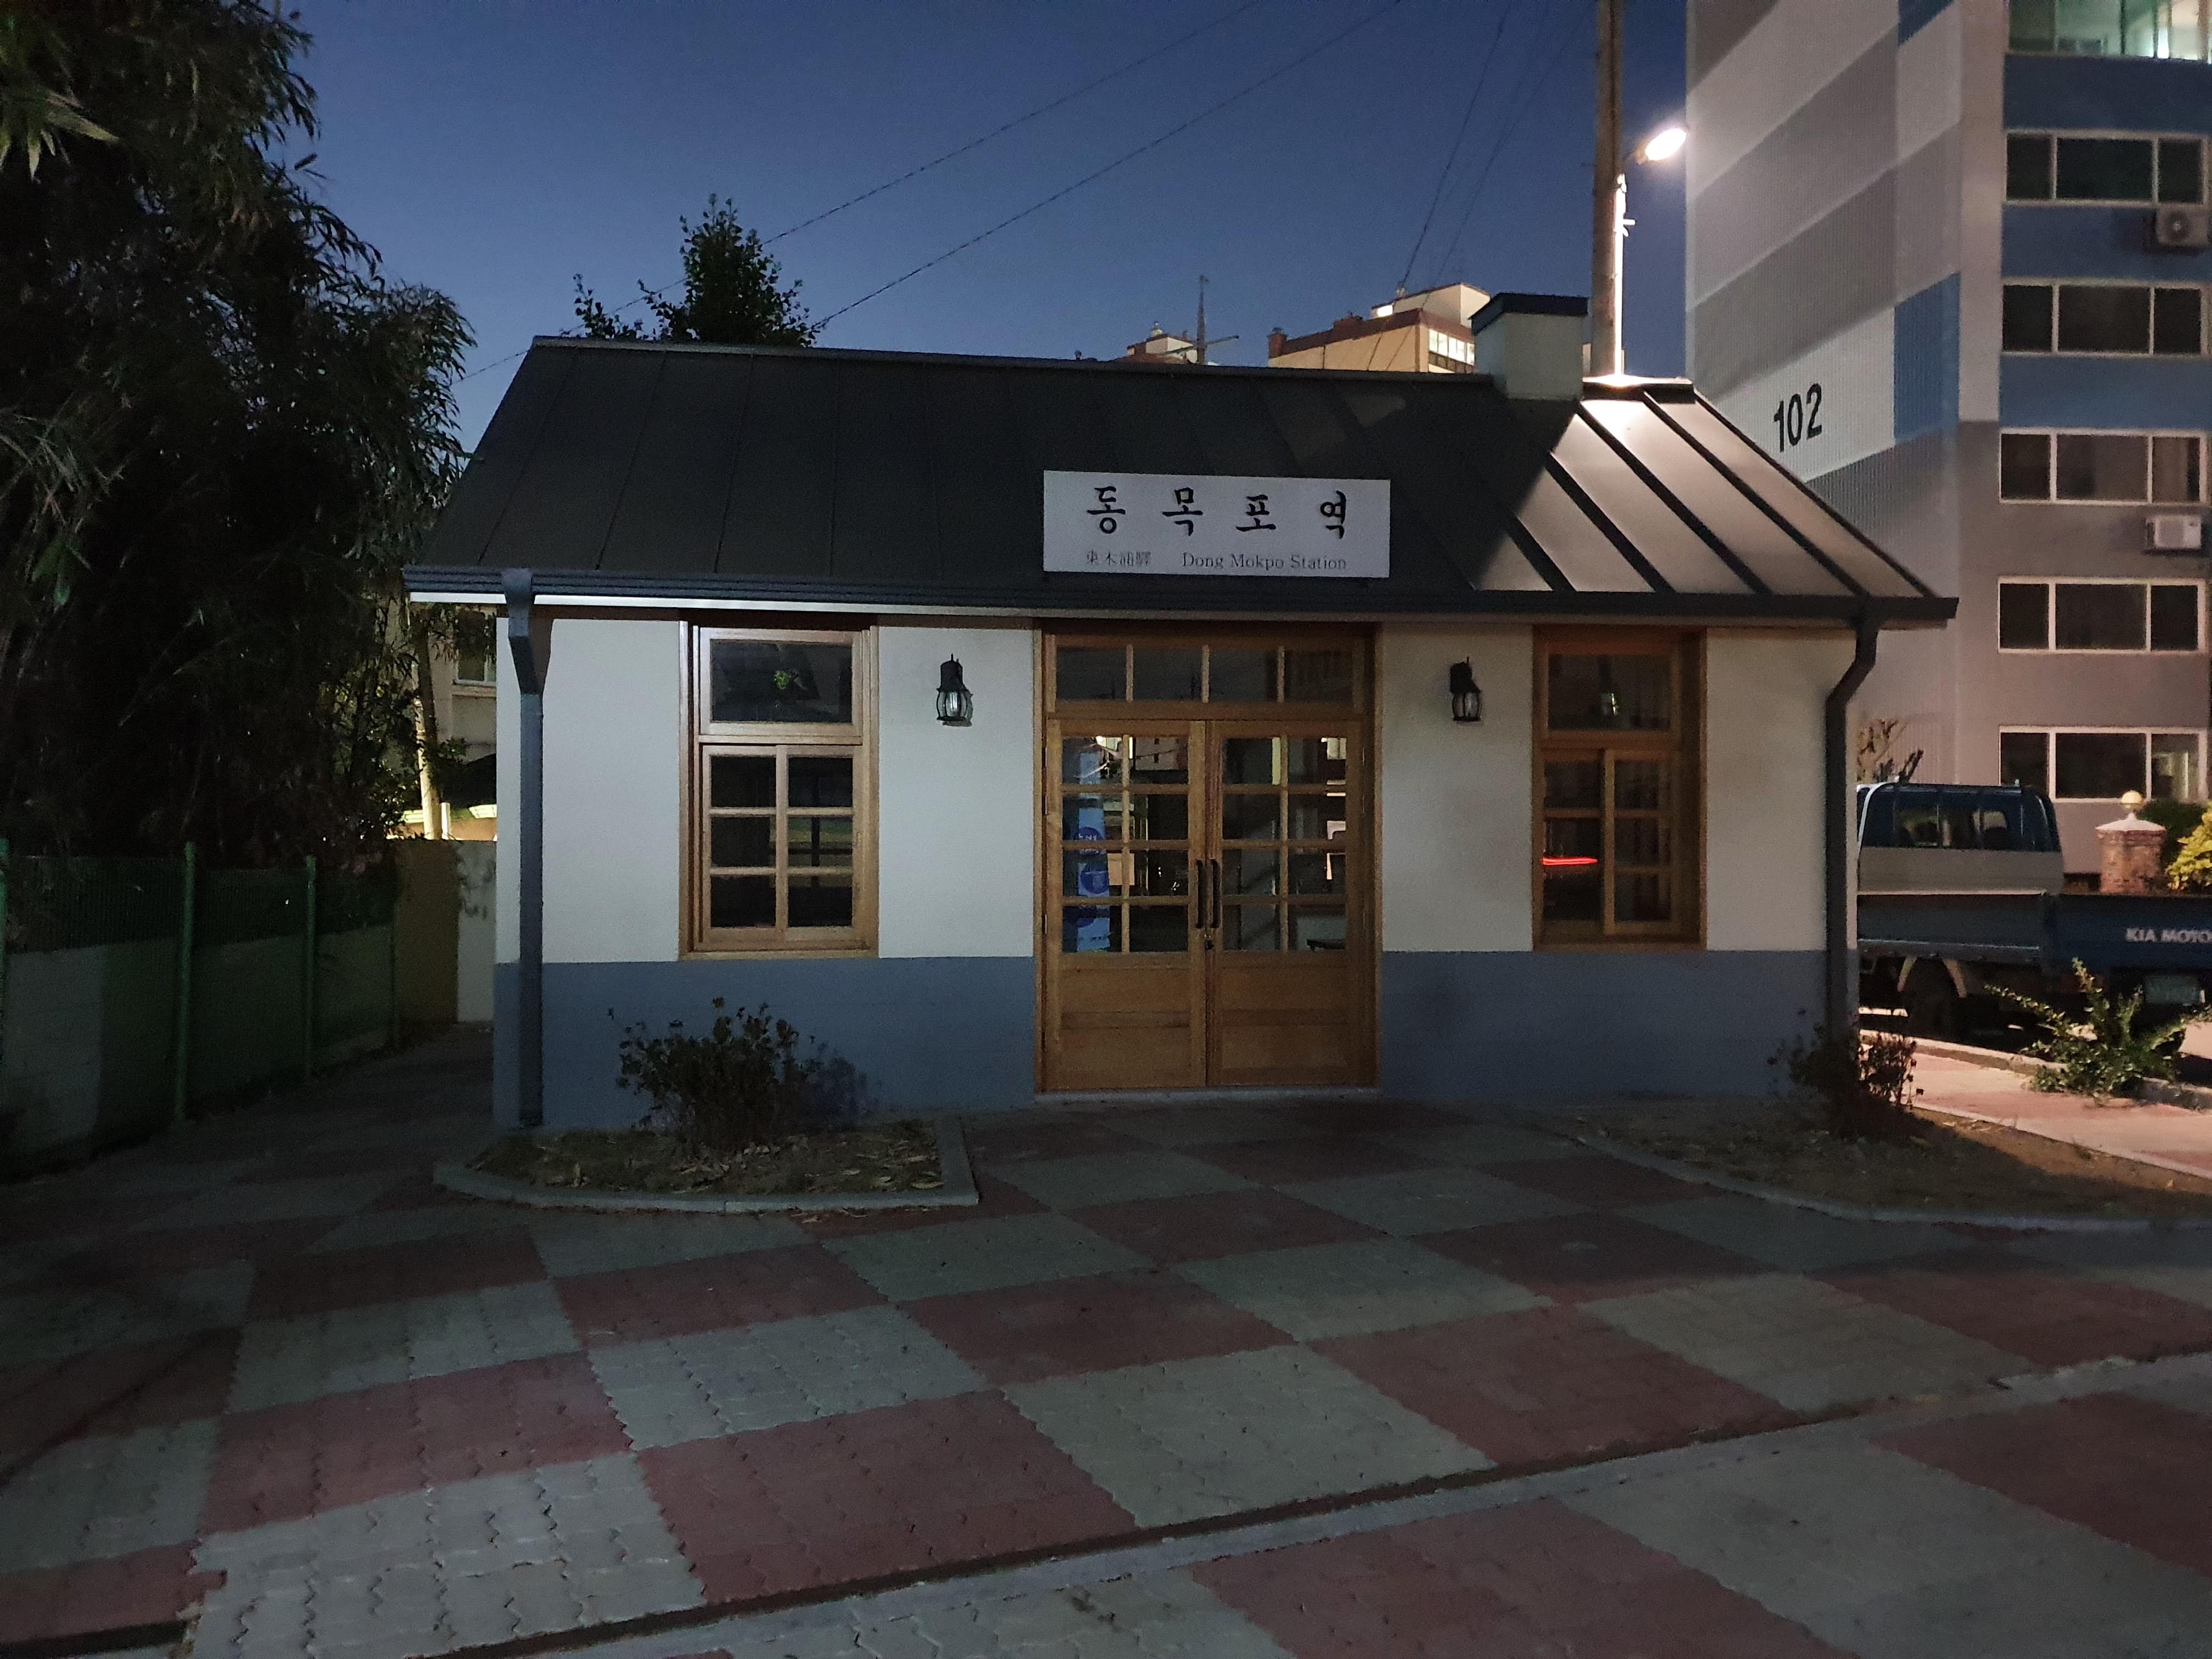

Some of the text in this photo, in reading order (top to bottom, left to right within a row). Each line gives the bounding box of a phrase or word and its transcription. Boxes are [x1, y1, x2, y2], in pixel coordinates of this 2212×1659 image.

[1774, 382, 1822, 454] 102
[1182, 552, 1346, 571] Dong Mokpo Station
[2126, 928, 2155, 942] KIA
